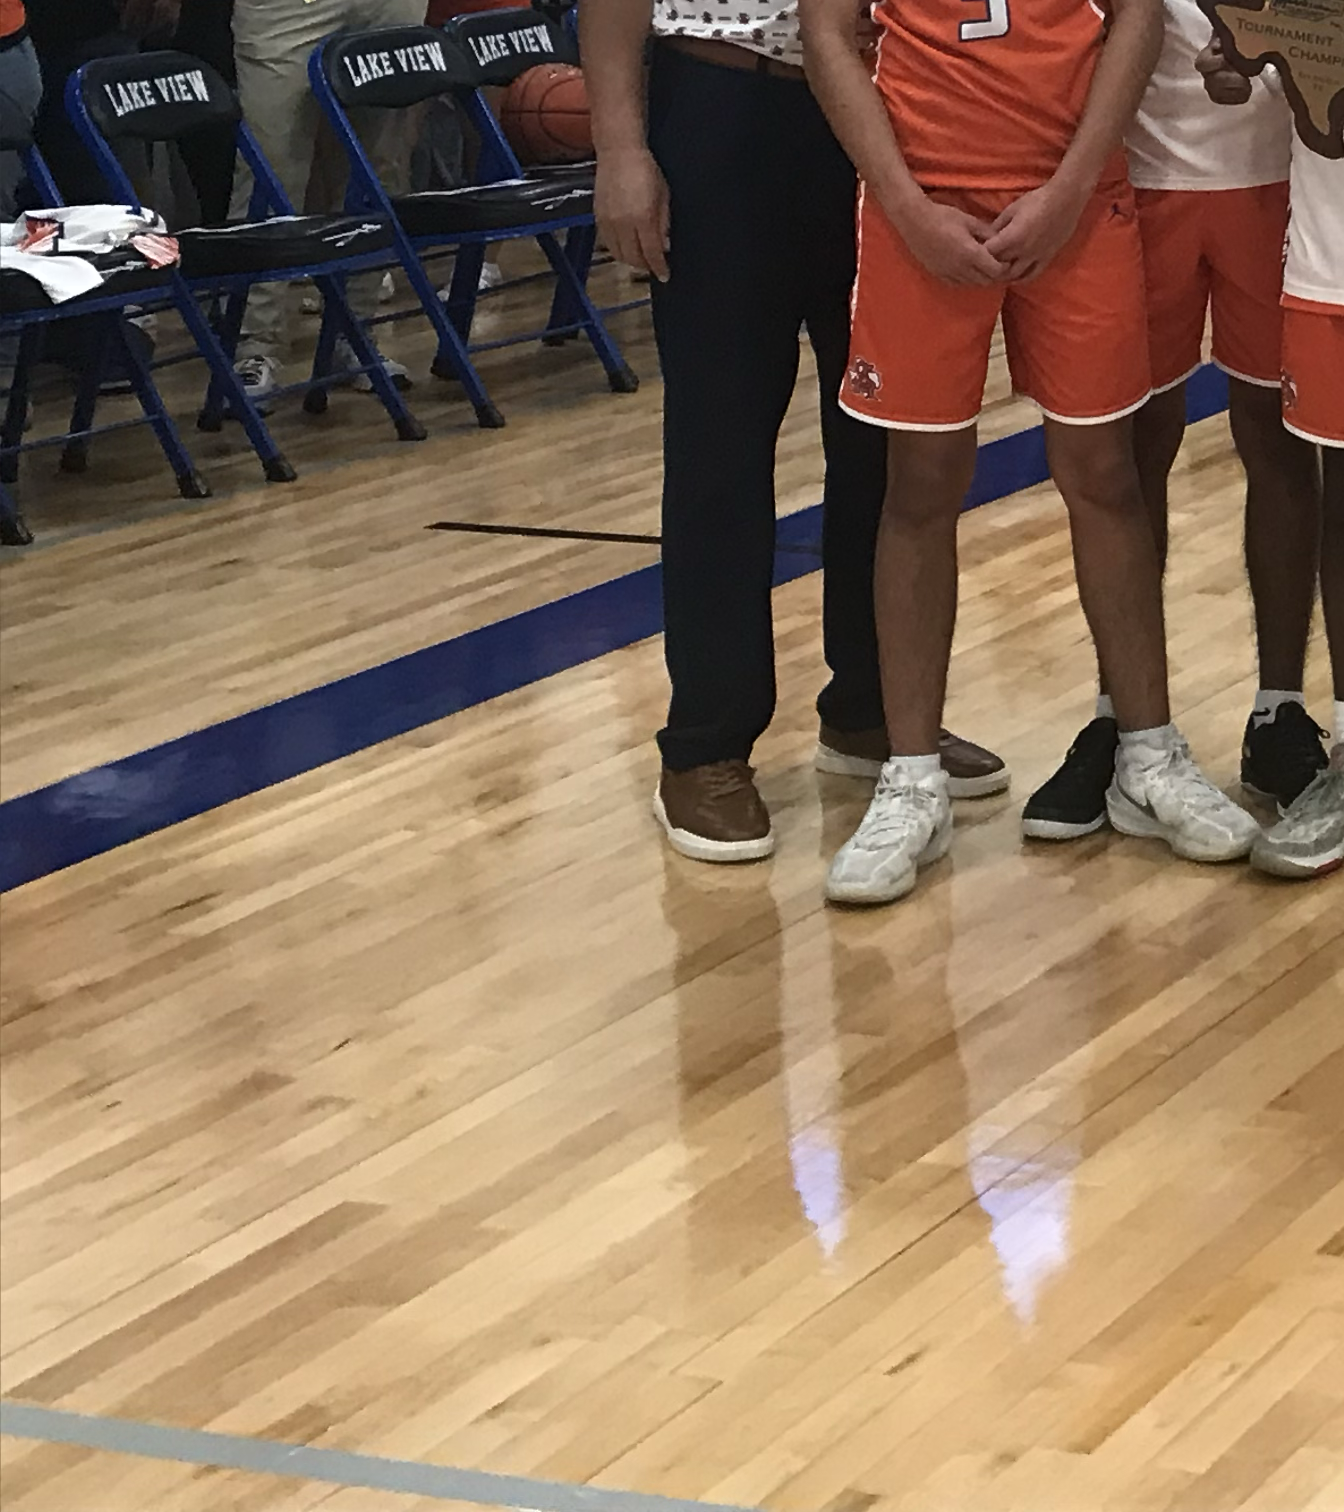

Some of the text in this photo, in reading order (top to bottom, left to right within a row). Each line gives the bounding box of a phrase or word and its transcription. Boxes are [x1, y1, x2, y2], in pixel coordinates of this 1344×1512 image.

[468, 25, 554, 67] LAKE VIEW
[1236, 17, 1334, 47] TOURNAMENT
[343, 41, 447, 87] LAKE VIEW
[104, 69, 210, 118] LAKE VIEW
